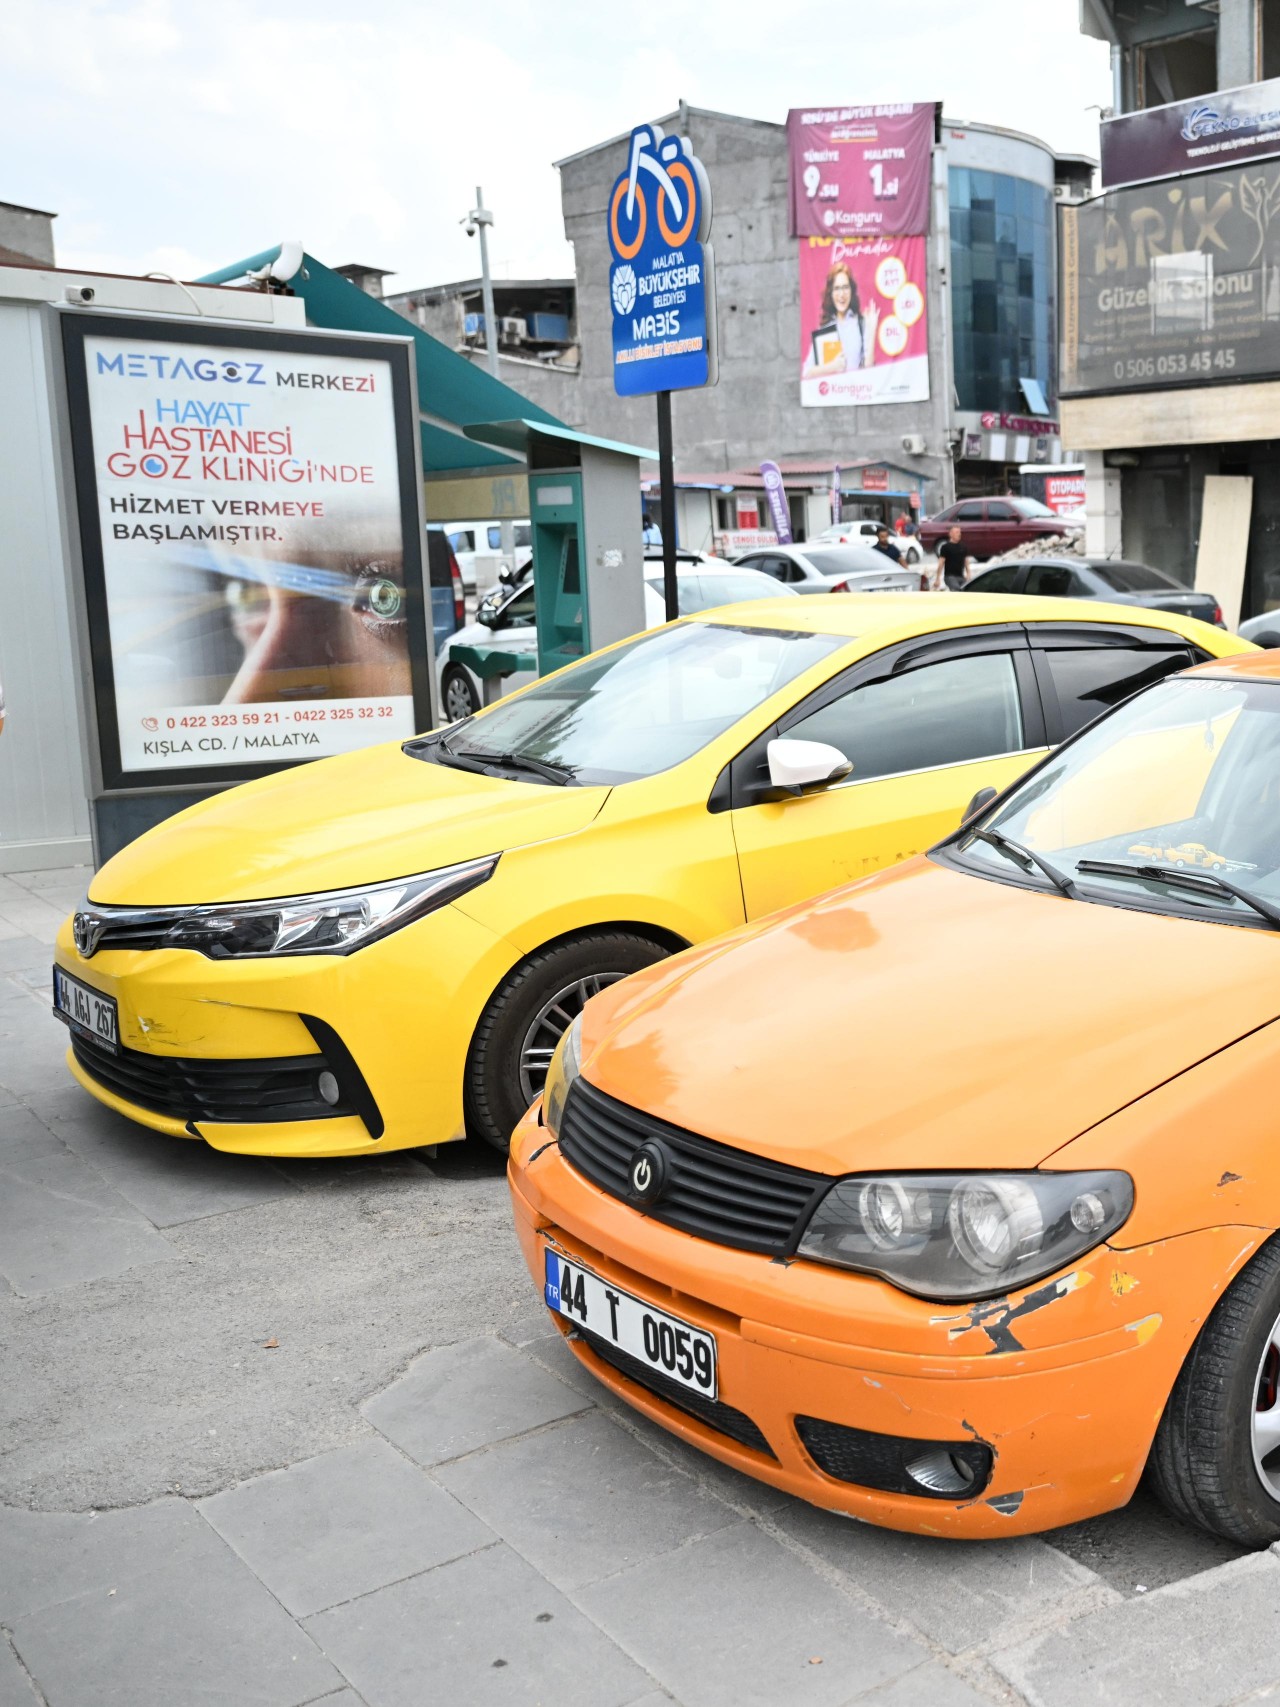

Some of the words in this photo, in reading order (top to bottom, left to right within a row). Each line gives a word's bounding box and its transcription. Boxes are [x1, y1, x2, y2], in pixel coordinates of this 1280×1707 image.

[835, 211, 882, 227] Kanguru
[652, 251, 685, 270] MALATYA
[638, 264, 701, 296] BÜYÜKŞEHİR
[653, 290, 686, 308] BELEDİYESİ
[1114, 362, 1124, 379] 0
[1126, 358, 1154, 378] 506
[1157, 354, 1188, 375] 053
[1190, 351, 1212, 371] 45
[1214, 349, 1235, 368] 45
[276, 371, 375, 393] MERKEZİ
[831, 382, 873, 396] Kanguru
[156, 398, 250, 427] HAYAT
[123, 410, 293, 456] HASTANESİ
[110, 493, 205, 515] HİZMET
[212, 500, 324, 517] VERMEYE
[113, 524, 283, 545] BAŞLAMIŞTIR.
[167, 717, 175, 729] 0
[180, 715, 207, 728] 422
[211, 714, 237, 726] 323
[242, 713, 259, 725] 59
[263, 712, 280, 724] 21
[293, 710, 326, 722] 0422
[330, 708, 354, 720] 325
[358, 707, 374, 718] 32
[378, 706, 393, 717] 32
[143, 740, 192, 758] KIŞLA
[198, 737, 227, 751] CD.
[244, 732, 320, 749] MALATYA
[74, 987, 91, 1026] AGJ
[95, 1002, 115, 1039] 267
[547, 1284, 559, 1300] TR
[561, 1264, 587, 1323] 44
[605, 1288, 620, 1342] T
[643, 1313, 712, 1389] 0059
